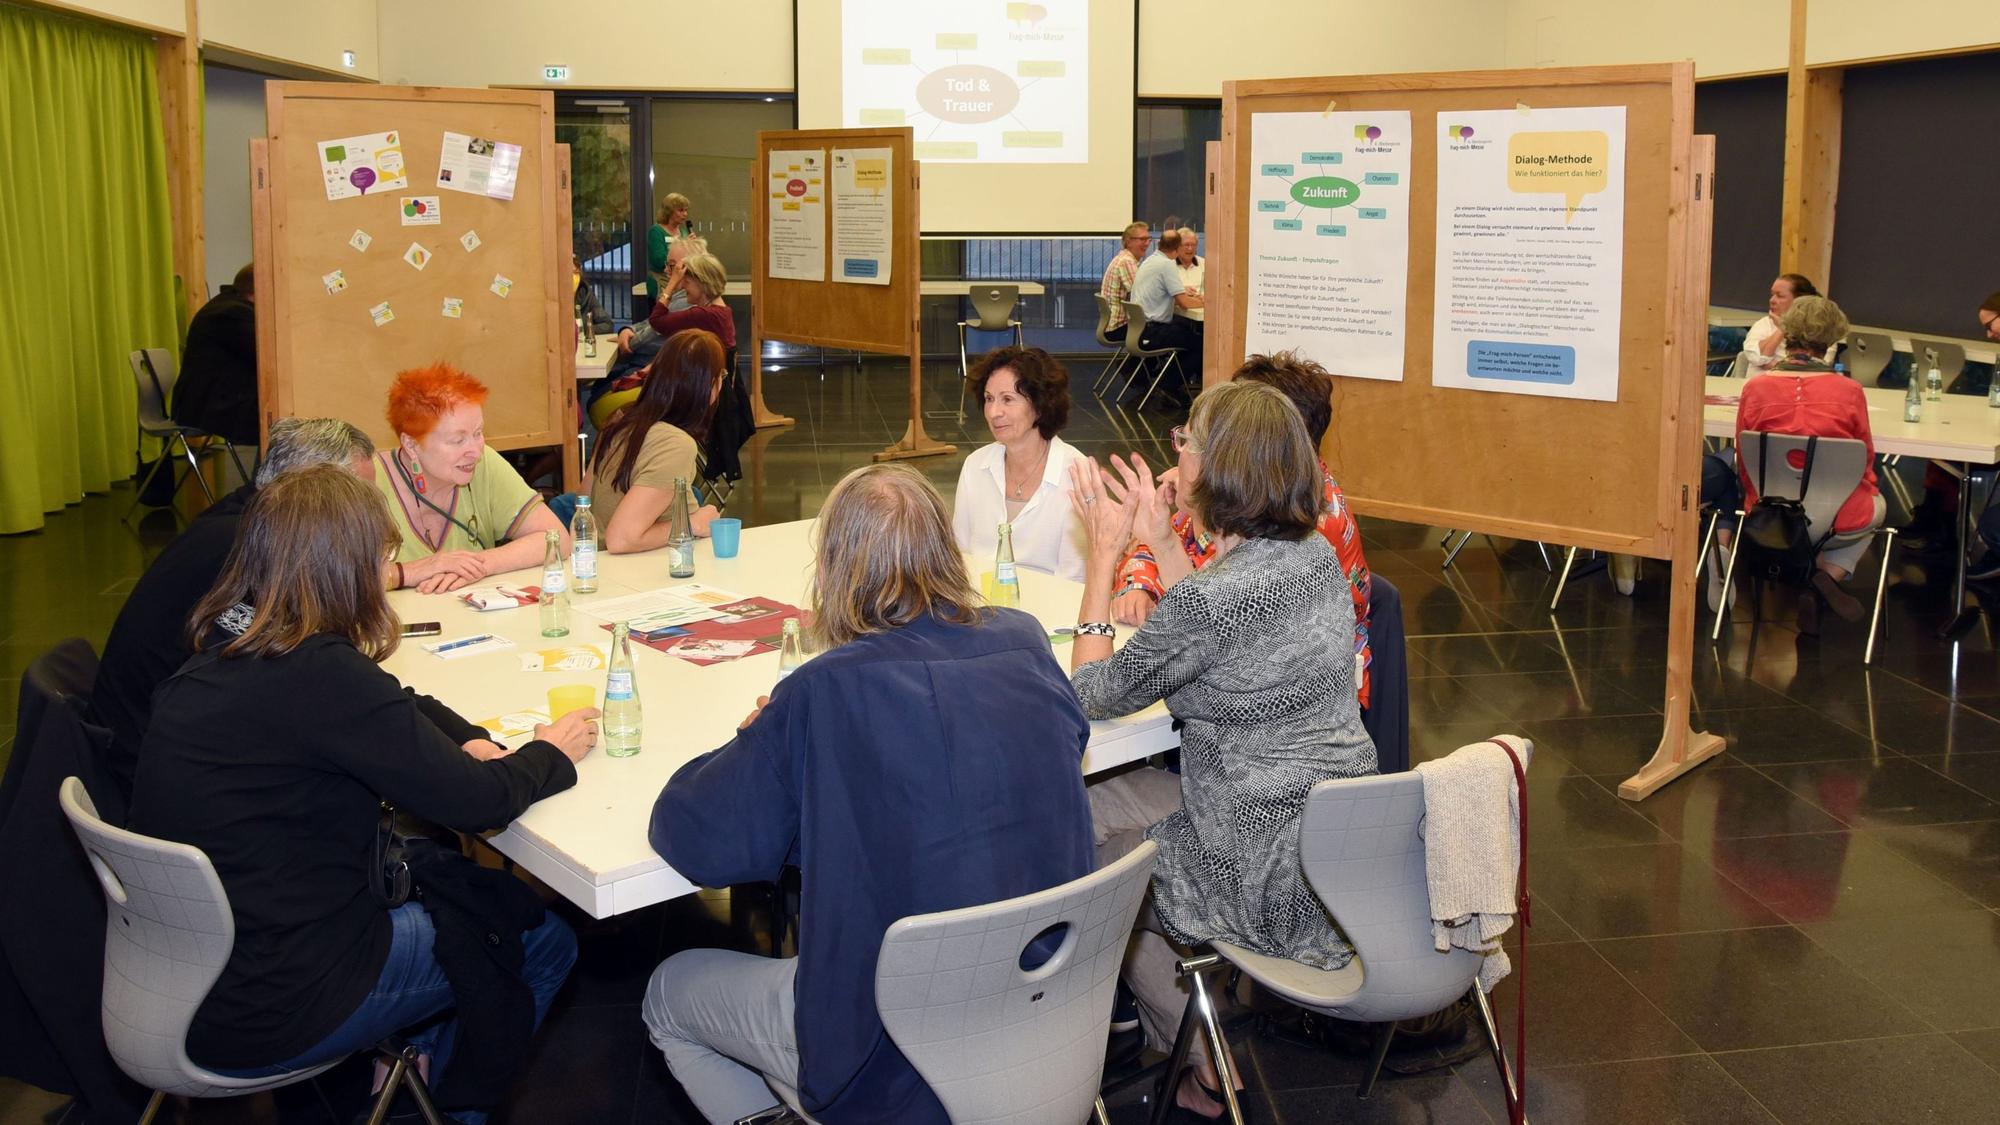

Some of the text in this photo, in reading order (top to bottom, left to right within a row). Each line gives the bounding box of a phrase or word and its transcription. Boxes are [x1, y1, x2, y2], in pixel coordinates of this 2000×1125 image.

[945, 78, 991, 92] Tod &
[943, 99, 993, 112] Trauer
[1515, 155, 1593, 166] Dialog-Methode
[1268, 166, 1287, 174] Hoffnung
[1303, 187, 1348, 198] Zukunft
